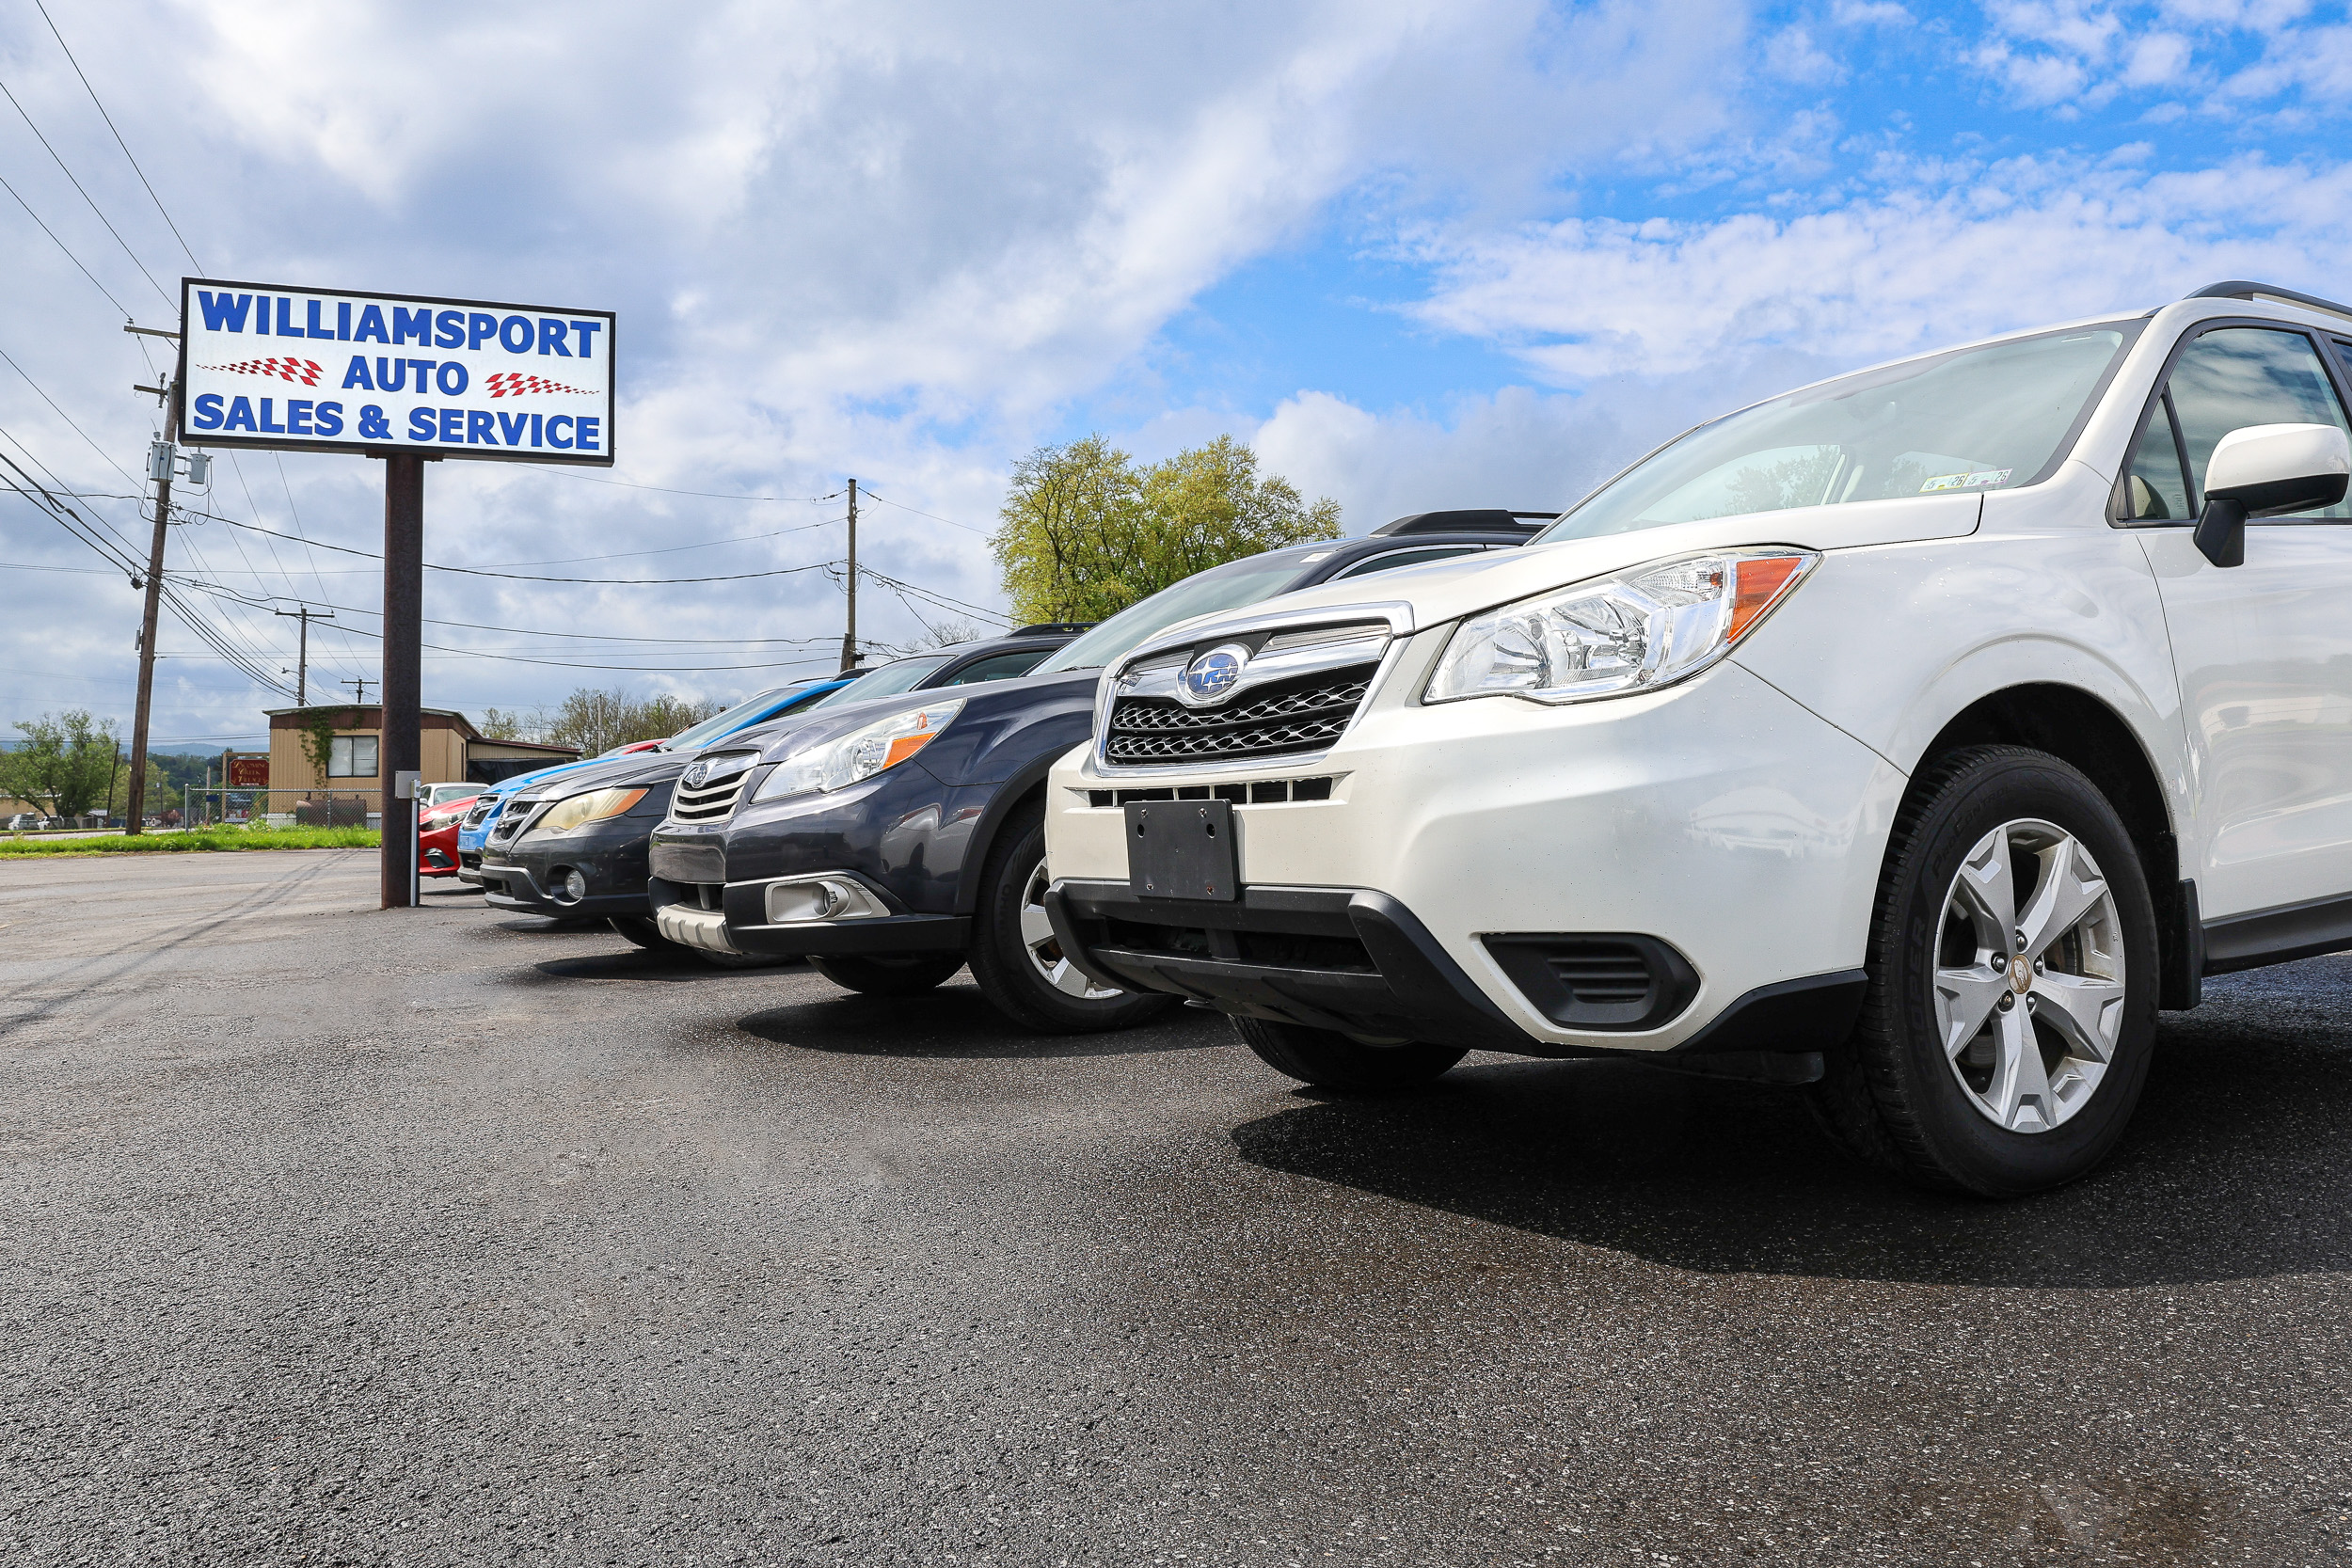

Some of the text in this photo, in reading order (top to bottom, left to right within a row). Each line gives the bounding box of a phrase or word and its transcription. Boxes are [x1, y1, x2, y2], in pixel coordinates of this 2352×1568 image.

[198, 290, 601, 359] WILLIAMSPORT
[342, 355, 469, 396] AUTO
[193, 393, 600, 451] SALES & SERVICE
[1951, 475, 1964, 485] 26
[1994, 471, 2009, 482] 26
